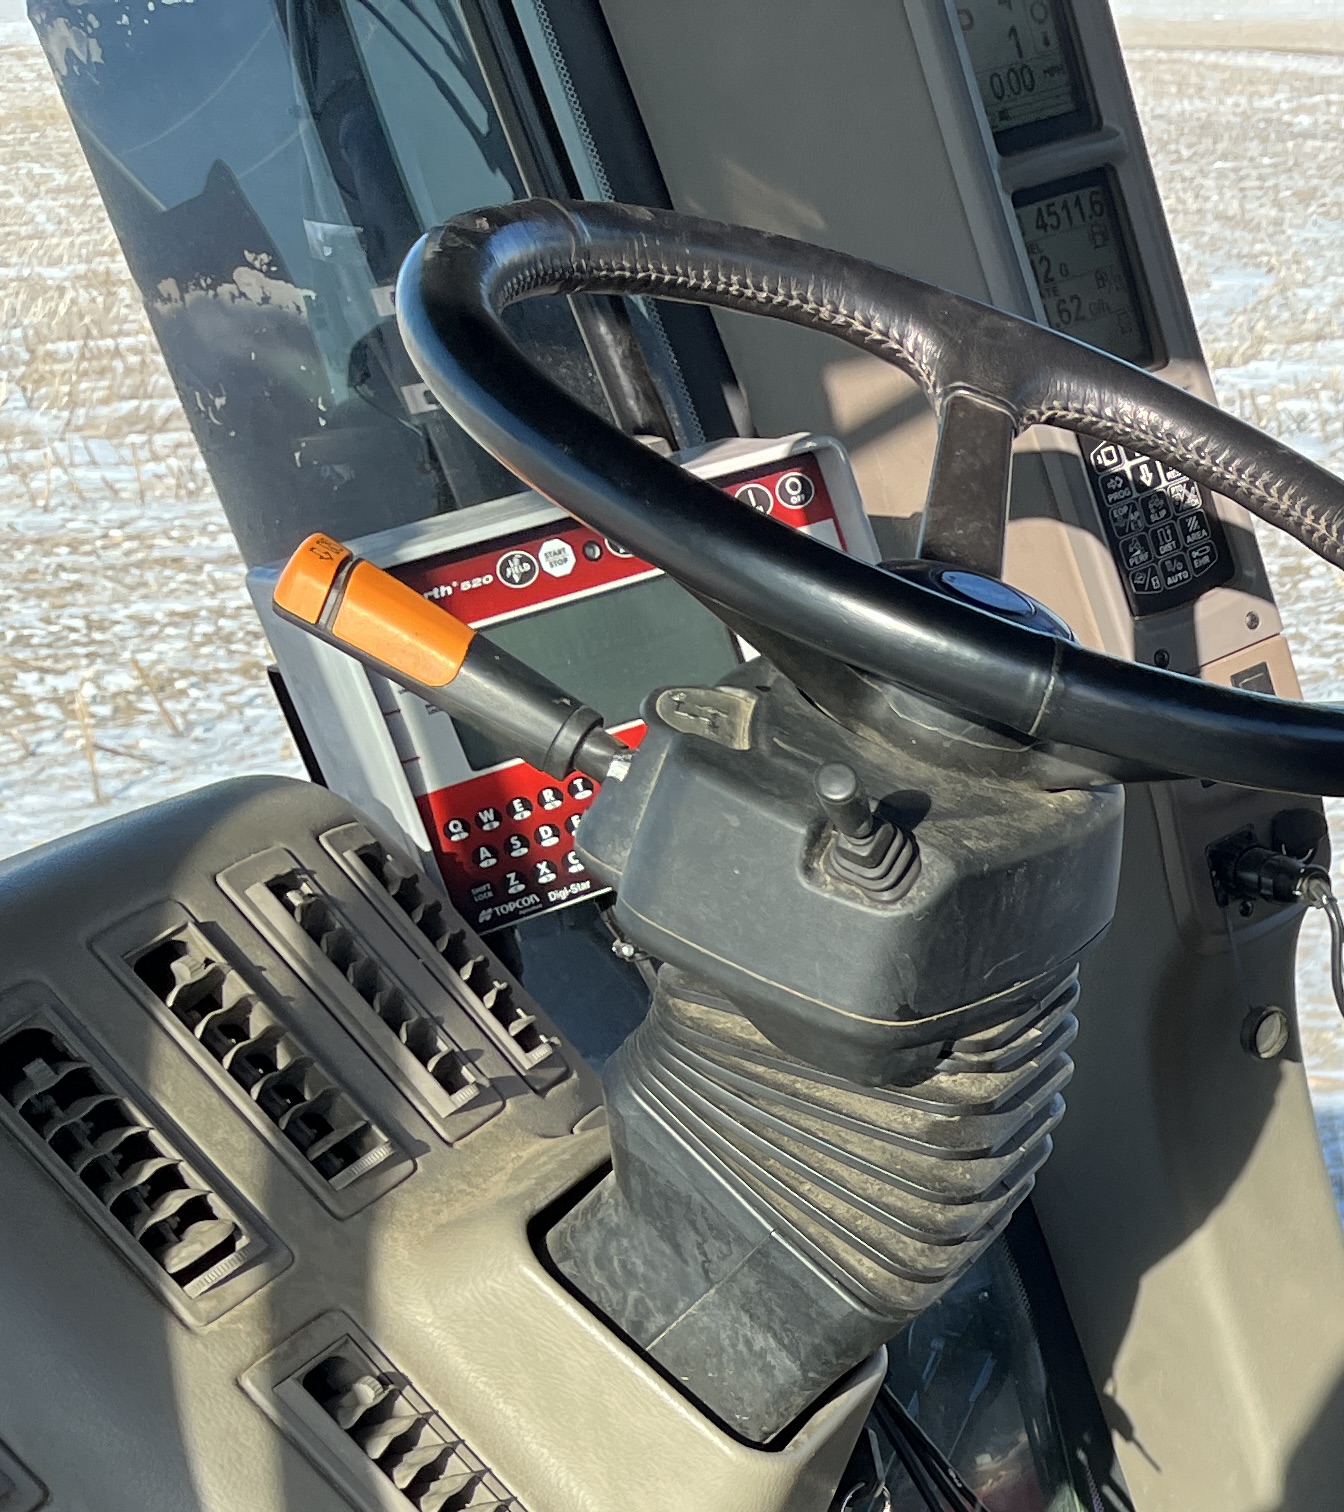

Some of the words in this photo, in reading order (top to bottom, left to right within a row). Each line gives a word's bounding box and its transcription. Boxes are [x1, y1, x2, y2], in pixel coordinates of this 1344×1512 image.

[989, 63, 1036, 101] 0.00
[1034, 190, 1105, 234] 4511.6
[543, 545, 567, 560] START
[548, 557, 569, 571] STOP
[460, 573, 494, 593] 520
[1166, 569, 1190, 586] AUTO
[448, 820, 464, 834] Q
[478, 808, 495, 823] W
[512, 798, 525, 812] E
[542, 788, 556, 802] R
[573, 778, 585, 792] T
[479, 847, 493, 860] A
[510, 836, 522, 849] S
[538, 826, 553, 839] D
[505, 872, 519, 886] Z
[535, 861, 552, 876] X
[567, 851, 580, 866] C
[547, 880, 592, 903] Digi-Star
[492, 893, 541, 917] TOPCON
